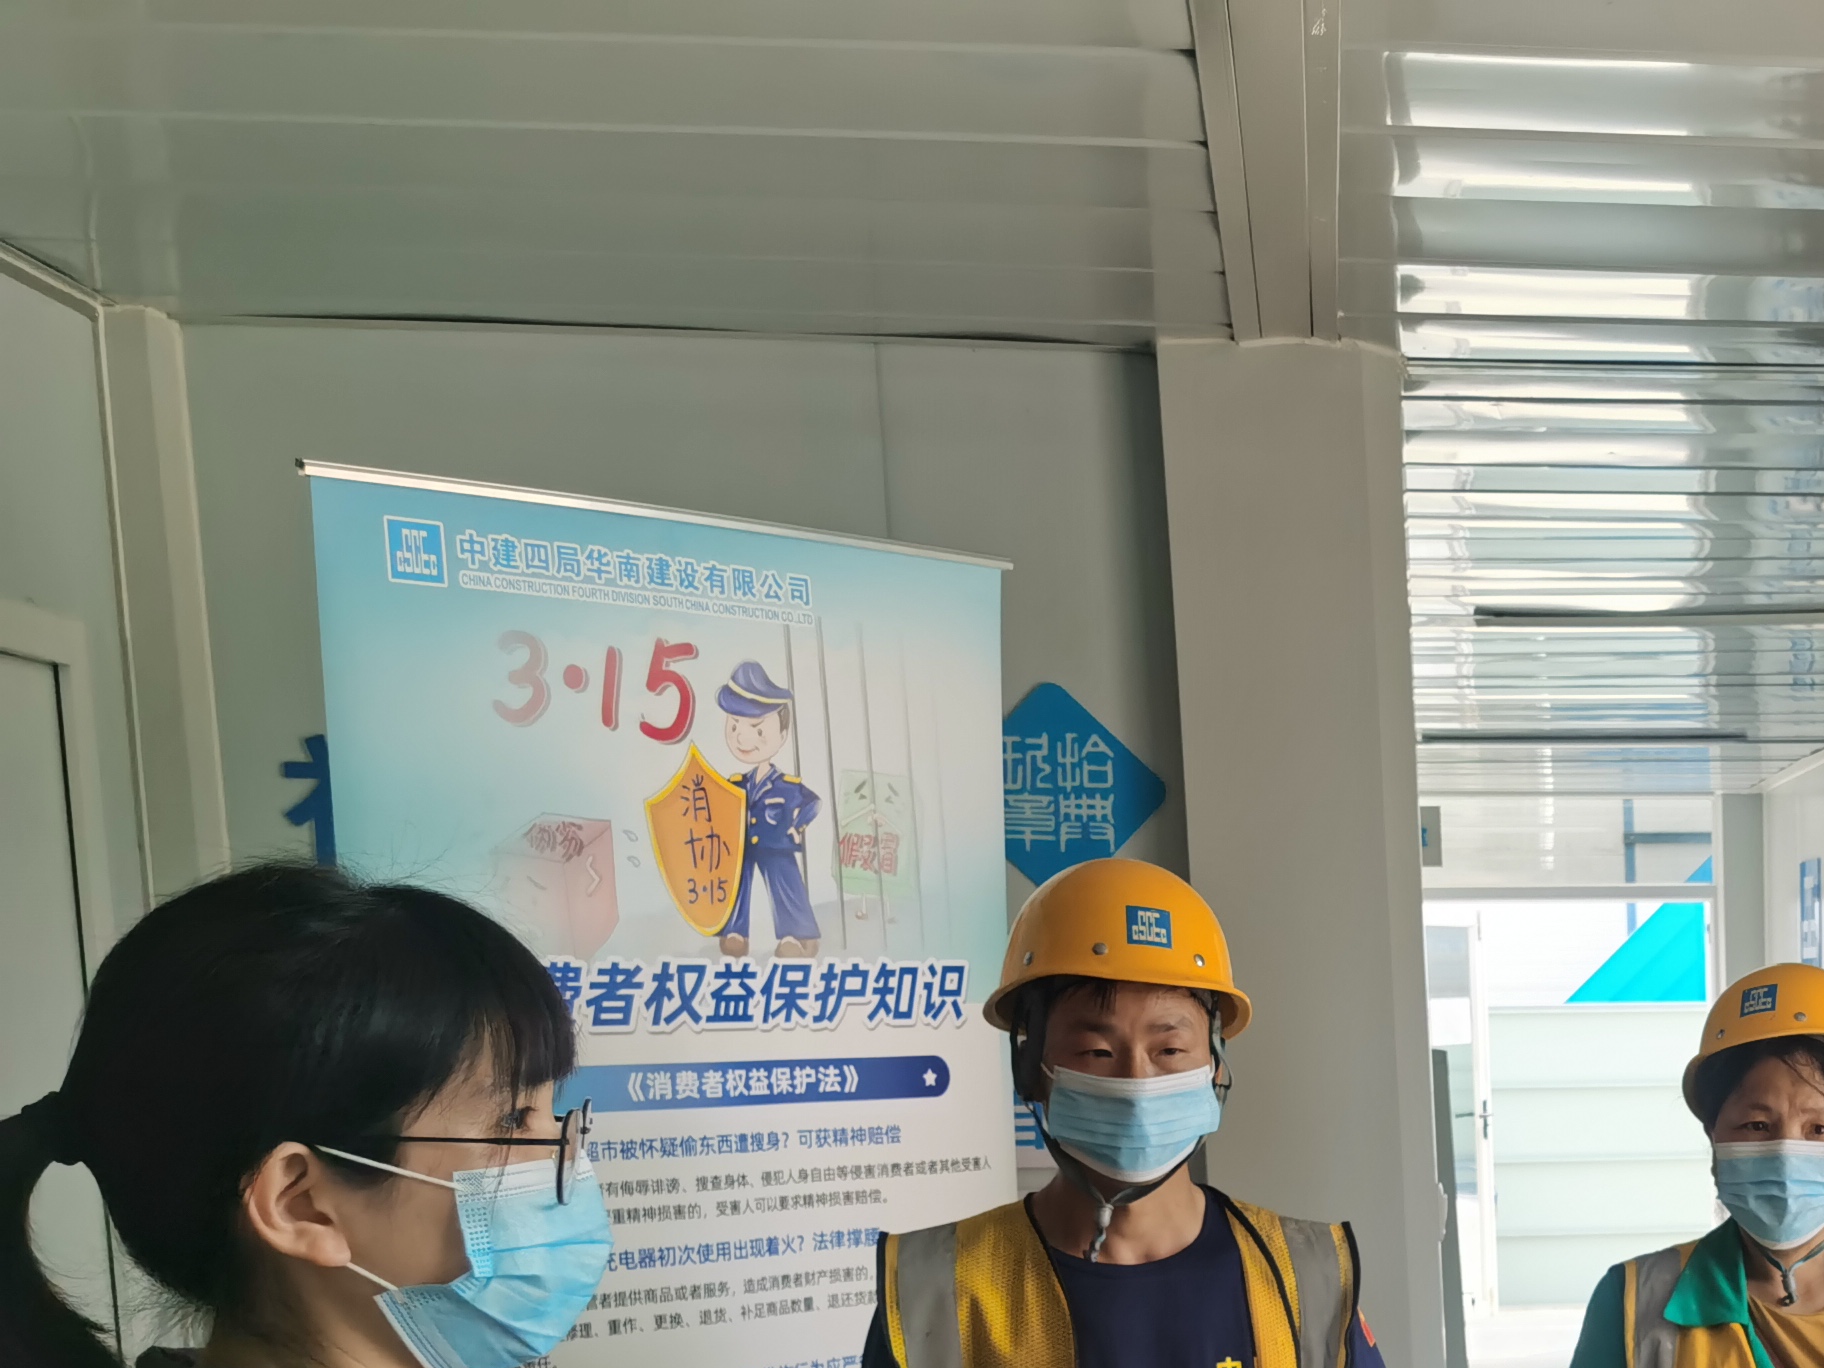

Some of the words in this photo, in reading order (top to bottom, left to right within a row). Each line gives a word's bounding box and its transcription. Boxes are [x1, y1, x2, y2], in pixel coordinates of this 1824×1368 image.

[457, 530, 812, 607] 中建四局华南建设有限公司
[461, 573, 493, 588] CHINA
[494, 576, 570, 597] CONSTRUCTION
[571, 588, 610, 602] FOURTH
[612, 590, 649, 606] DIVISION
[652, 595, 684, 610] SOUTH
[685, 599, 711, 614] CHINA
[712, 603, 780, 622] CONSTRUCTION
[680, 774, 731, 874] 消协
[626, 1064, 860, 1102] 《消费者权益保护法》
[599, 1155, 992, 1199] 有侮辱诽谤、搜查身体、侵犯人身自由等侵害消费者或者其他受害人
